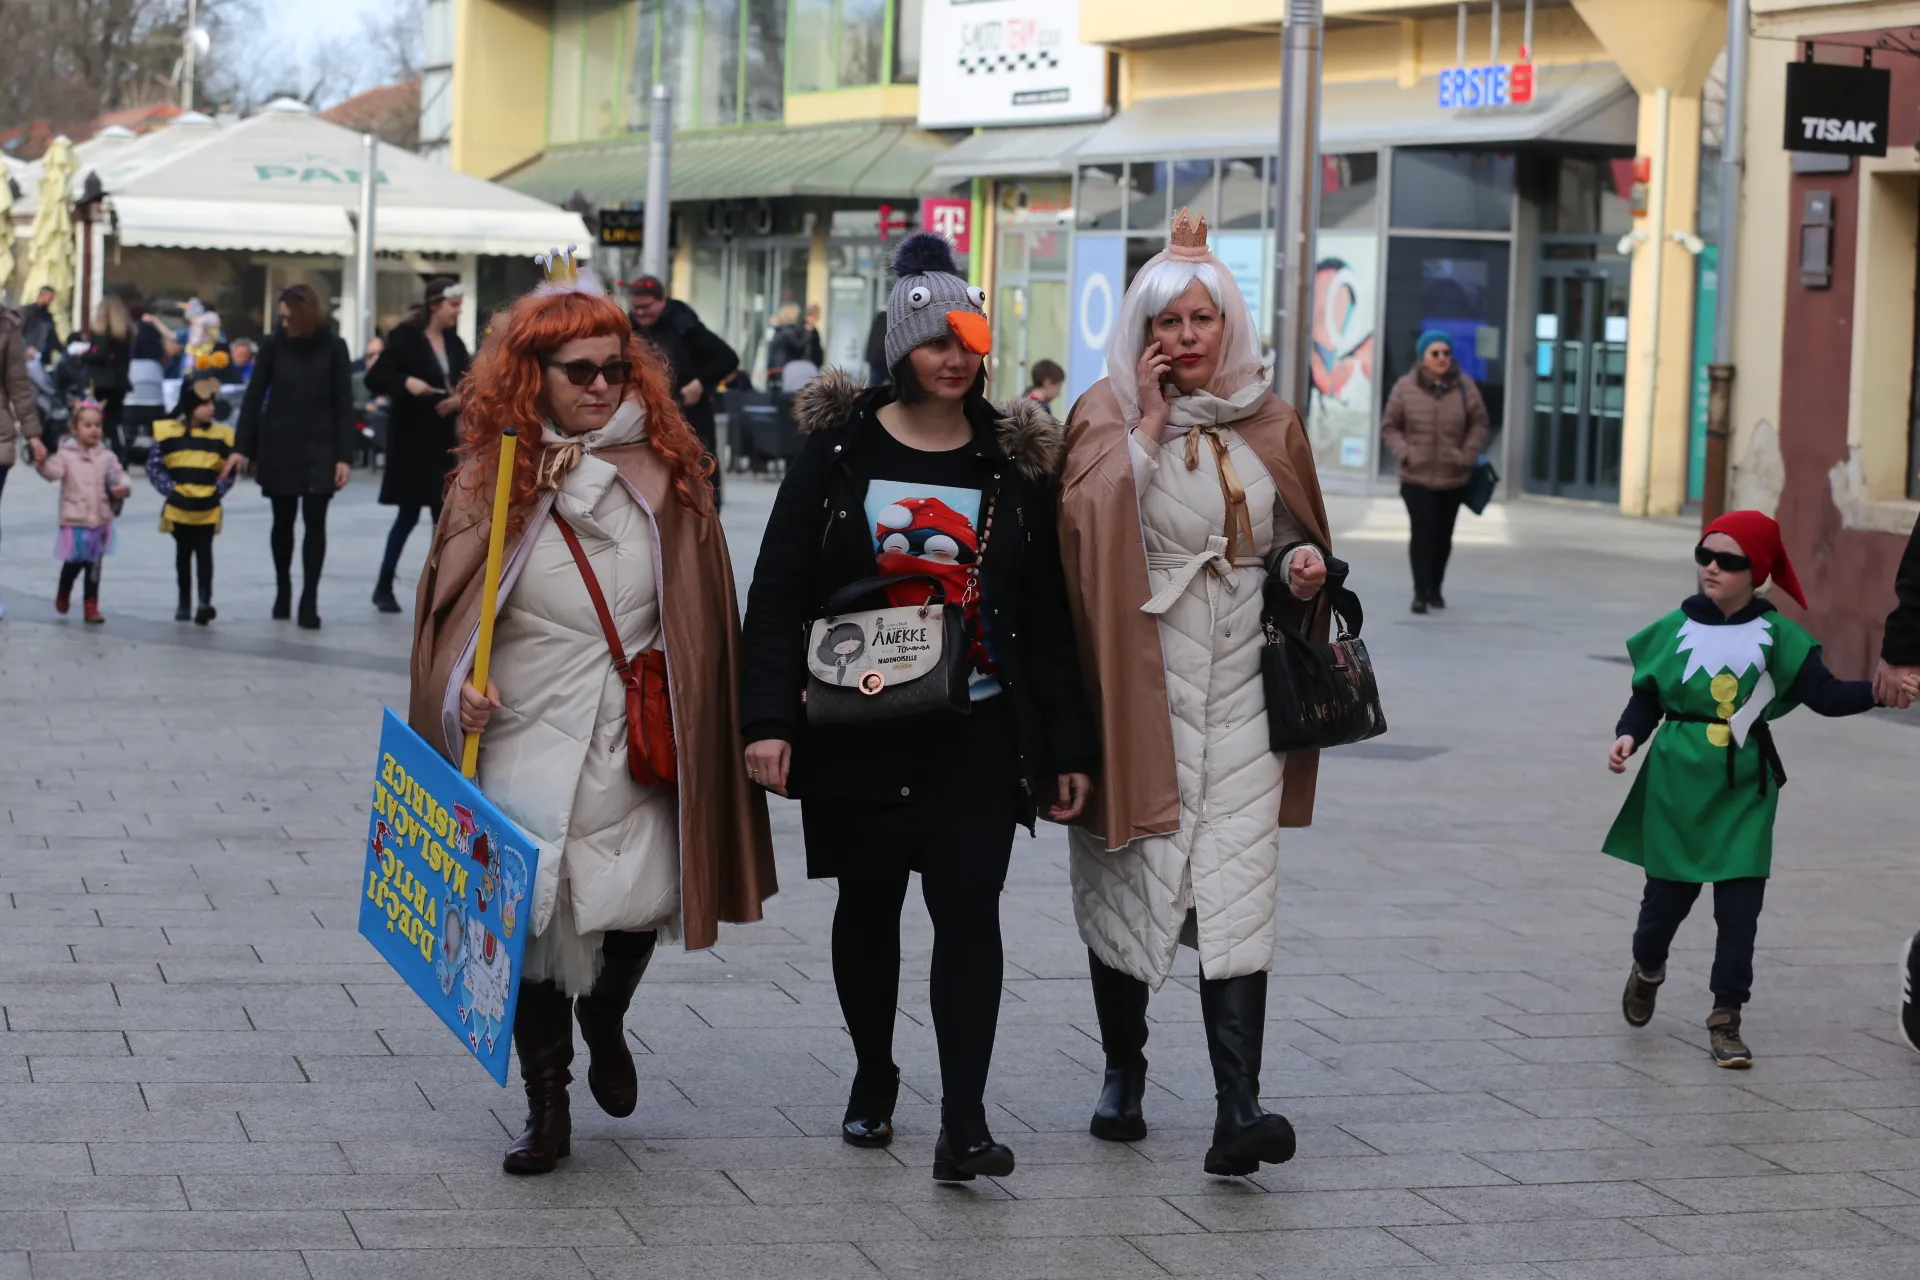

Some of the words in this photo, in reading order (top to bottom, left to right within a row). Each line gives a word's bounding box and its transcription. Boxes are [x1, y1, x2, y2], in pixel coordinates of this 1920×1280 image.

[1438, 65, 1510, 108] ERSTE
[1801, 116, 1877, 144] TISAK
[872, 628, 927, 646] ANEKKE
[382, 752, 458, 849] ISKRICE
[373, 780, 469, 899] MASLAČAK
[367, 870, 435, 963] DJEČJI
